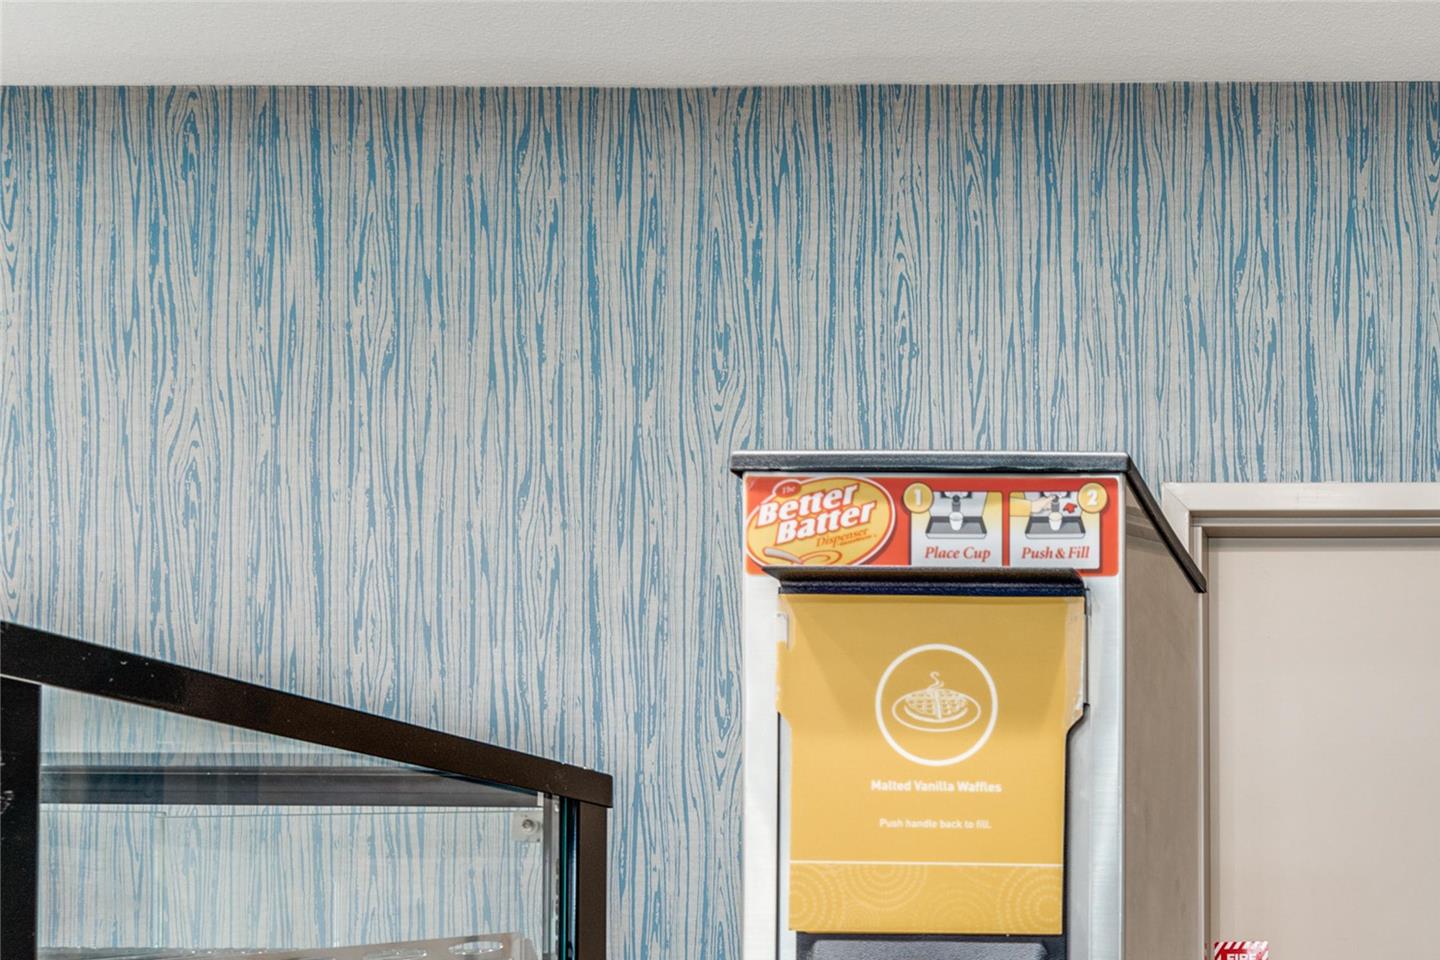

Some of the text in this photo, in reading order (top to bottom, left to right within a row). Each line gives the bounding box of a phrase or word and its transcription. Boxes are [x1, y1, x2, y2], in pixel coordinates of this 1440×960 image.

[781, 485, 796, 495] The
[913, 489, 922, 506] 1
[1087, 489, 1098, 506] 2
[756, 484, 859, 528] Better
[776, 502, 876, 545] Batter
[925, 547, 991, 562] Place Cup
[1021, 547, 1090, 560] Push & Fill
[871, 780, 1003, 793] Malted Vanilla Waffles
[879, 818, 903, 829] Push
[905, 818, 938, 829] handle
[940, 818, 962, 829] back
[964, 818, 975, 829] to
